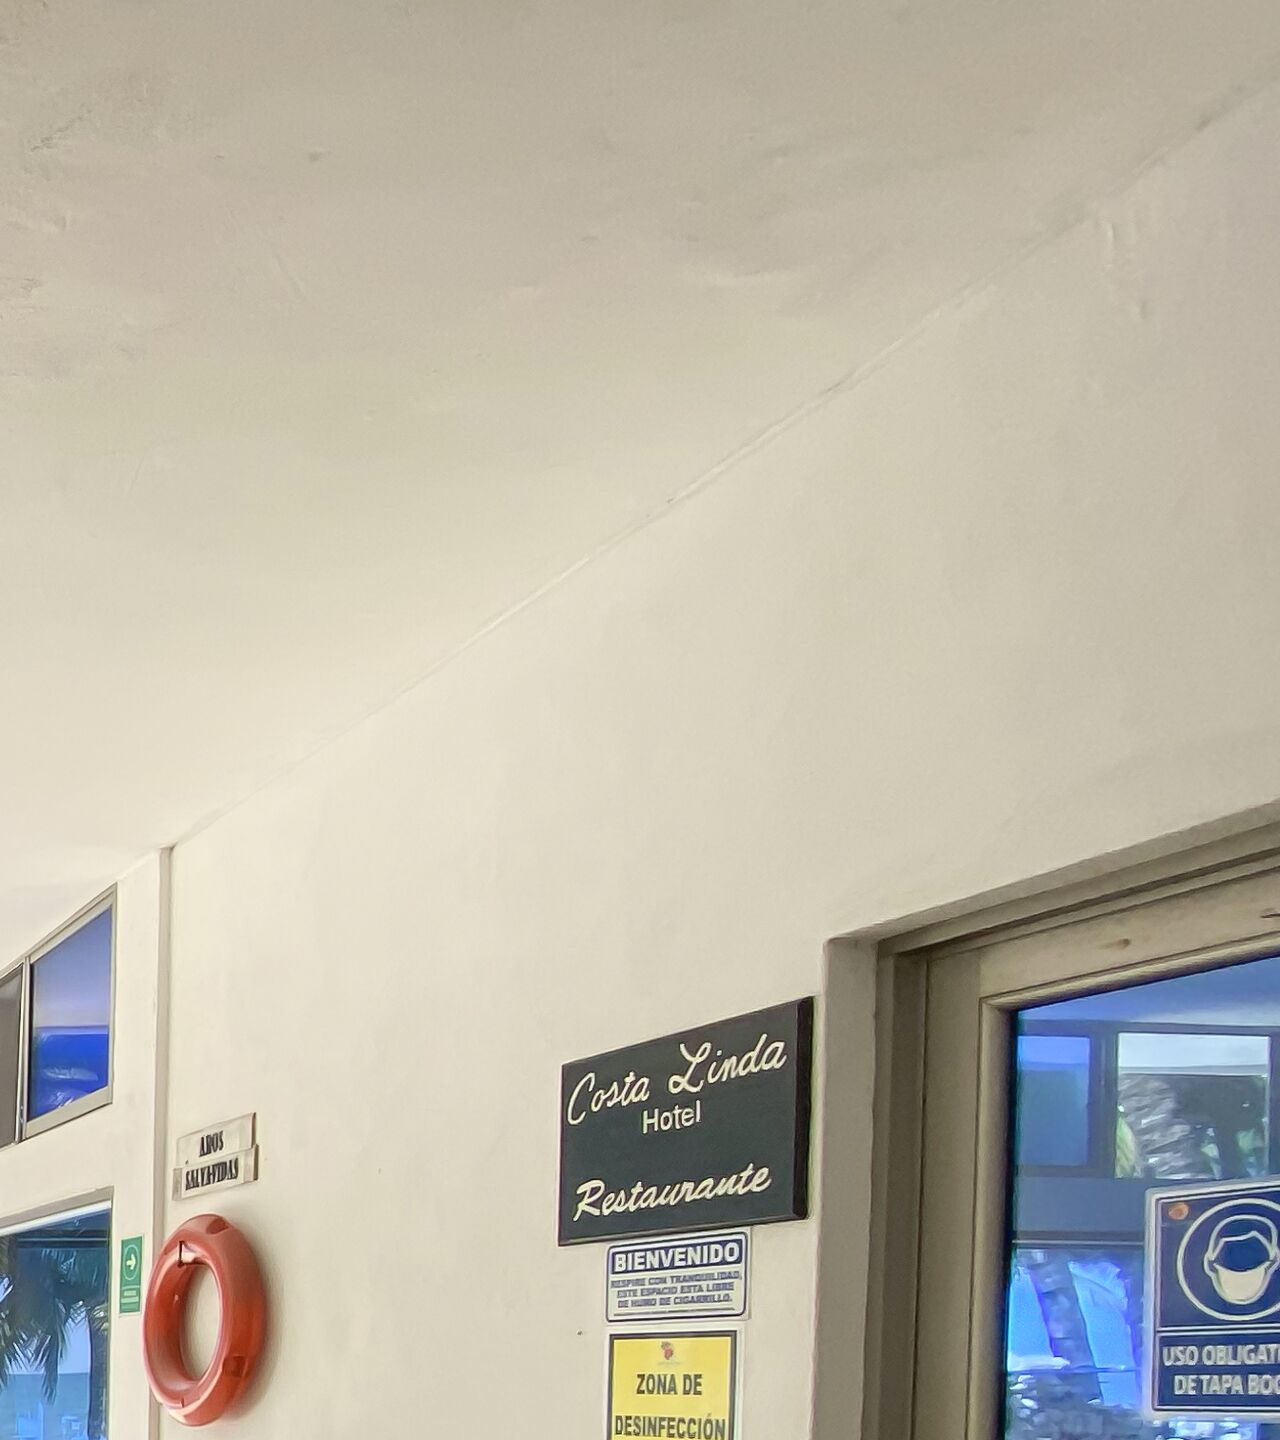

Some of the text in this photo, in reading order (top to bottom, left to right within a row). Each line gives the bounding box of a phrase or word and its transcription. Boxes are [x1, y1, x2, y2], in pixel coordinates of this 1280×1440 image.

[566, 1033, 788, 1126] Costa Linda
[642, 1100, 701, 1135] Hotel
[572, 1163, 772, 1222] Restaurante
[614, 1242, 740, 1272] BIENVENIDO
[617, 1289, 638, 1298] ESTE
[640, 1287, 678, 1296] ESPACIO
[706, 1282, 734, 1292] LIBRE
[648, 1276, 667, 1285] CON
[618, 1299, 629, 1308] DE
[631, 1298, 657, 1307] HUMO
[659, 1297, 671, 1306] DE
[1162, 1343, 1280, 1367] USO OBLIGAT
[636, 1373, 703, 1396] ZONA DE
[1174, 1374, 1198, 1395] DE
[1199, 1374, 1244, 1395] TAPA
[615, 1412, 726, 1440] DESINFECCIÓN
